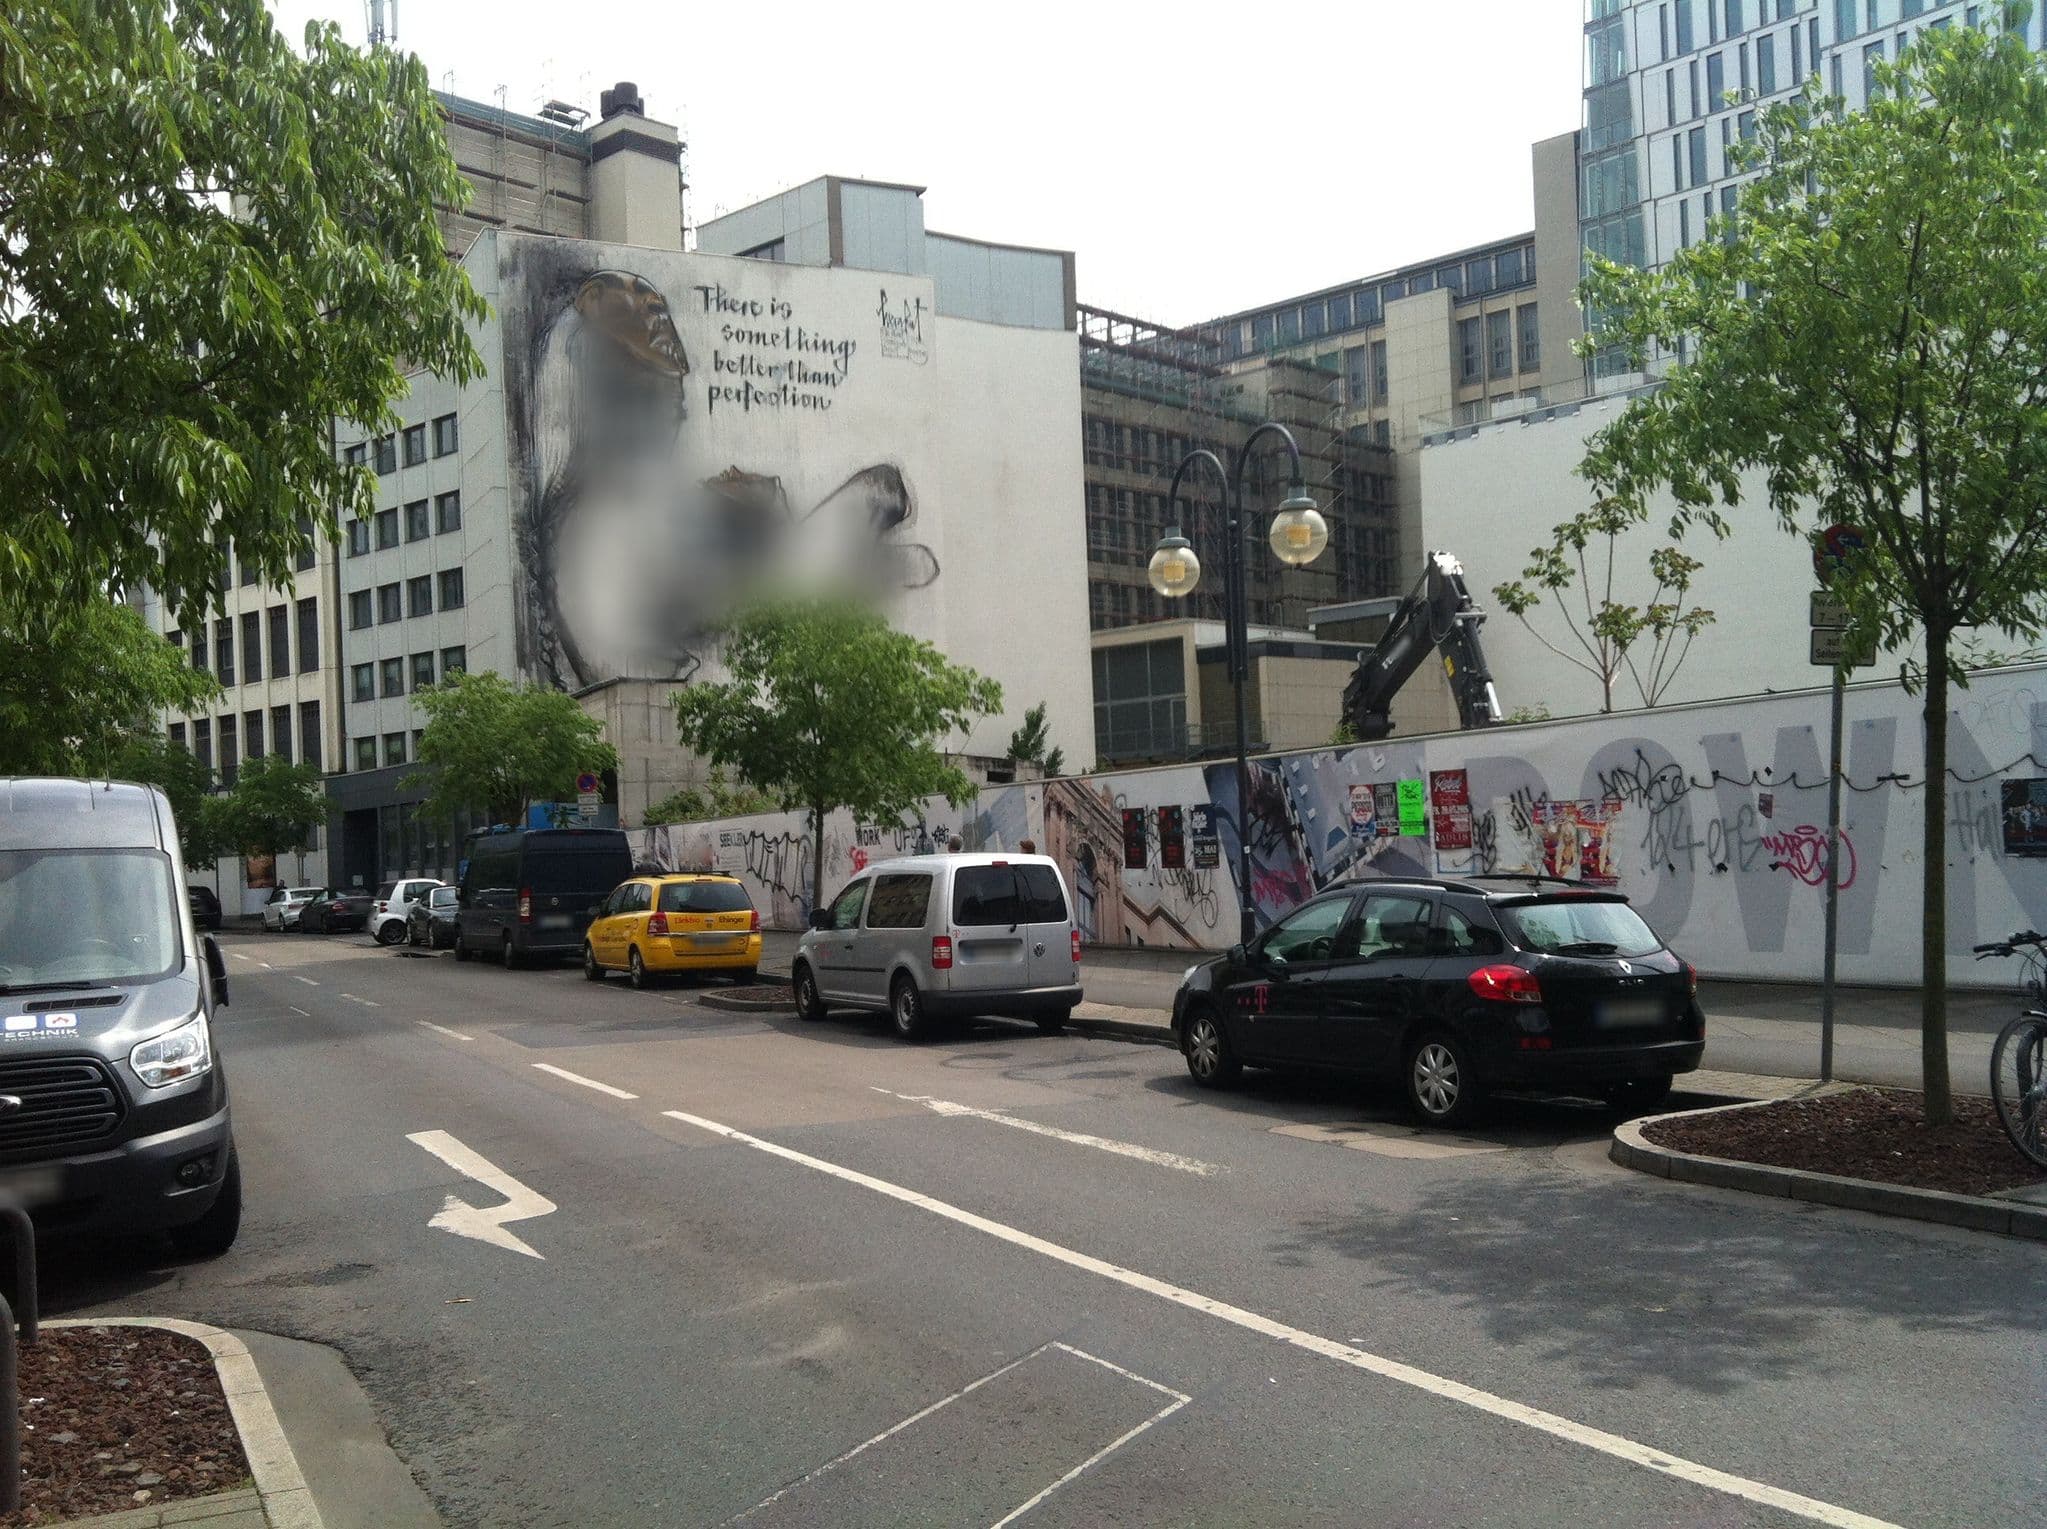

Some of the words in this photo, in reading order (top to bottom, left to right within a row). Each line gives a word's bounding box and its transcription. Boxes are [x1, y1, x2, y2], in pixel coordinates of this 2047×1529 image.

[693, 282, 764, 317] There
[770, 297, 793, 320] is
[721, 322, 857, 377] something
[713, 350, 779, 378] better
[788, 359, 844, 388] than
[708, 380, 832, 415] perfection
